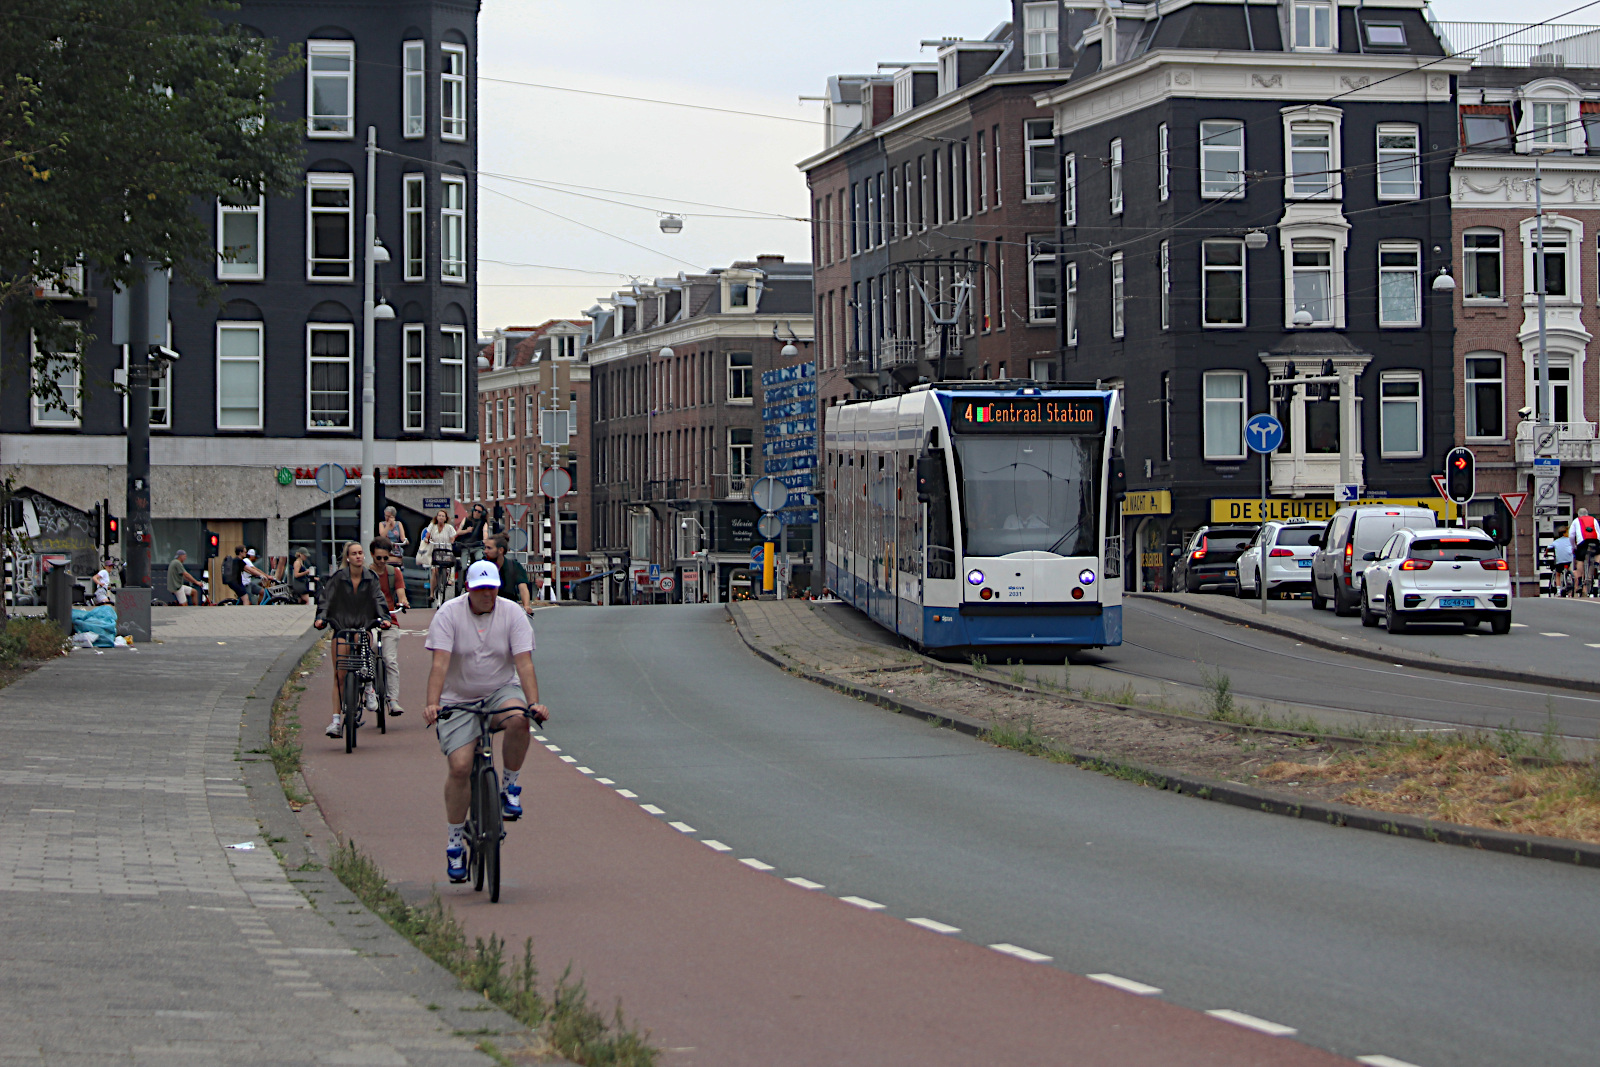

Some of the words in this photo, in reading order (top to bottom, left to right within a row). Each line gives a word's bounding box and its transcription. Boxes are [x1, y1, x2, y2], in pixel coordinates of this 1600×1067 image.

[964, 403, 973, 422] 4
[988, 402, 1042, 422] Centraal
[1046, 402, 1093, 422] Station
[388, 467, 444, 479] BHAVAN
[1129, 495, 1146, 511] WACHT
[1230, 502, 1252, 519] DE
[663, 579, 673, 589] 30
